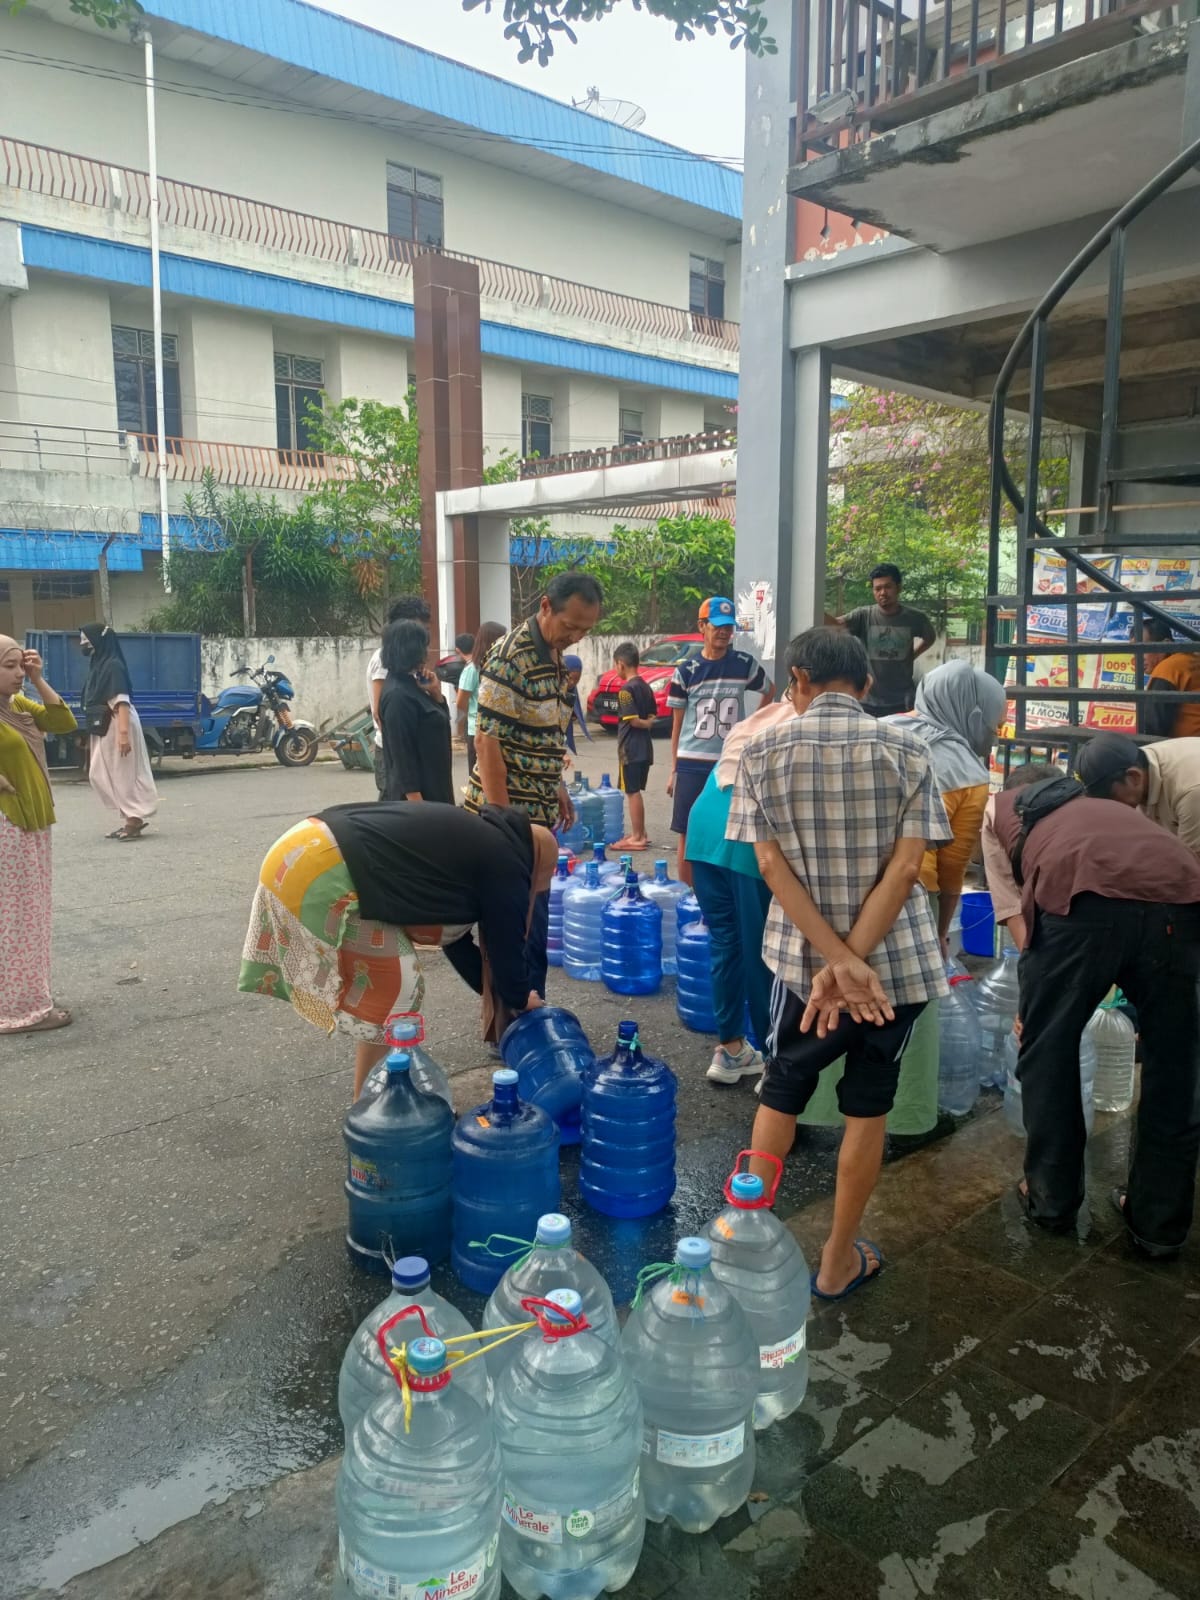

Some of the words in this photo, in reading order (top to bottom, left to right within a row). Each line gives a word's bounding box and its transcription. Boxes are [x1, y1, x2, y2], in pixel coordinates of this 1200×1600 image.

[694, 698, 740, 740] 69
[1100, 714, 1134, 726] PWP
[504, 1503, 550, 1534] Minerale
[518, 1507, 534, 1521] Le
[423, 1572, 479, 1600] Minerale
[449, 1569, 467, 1587] Le
